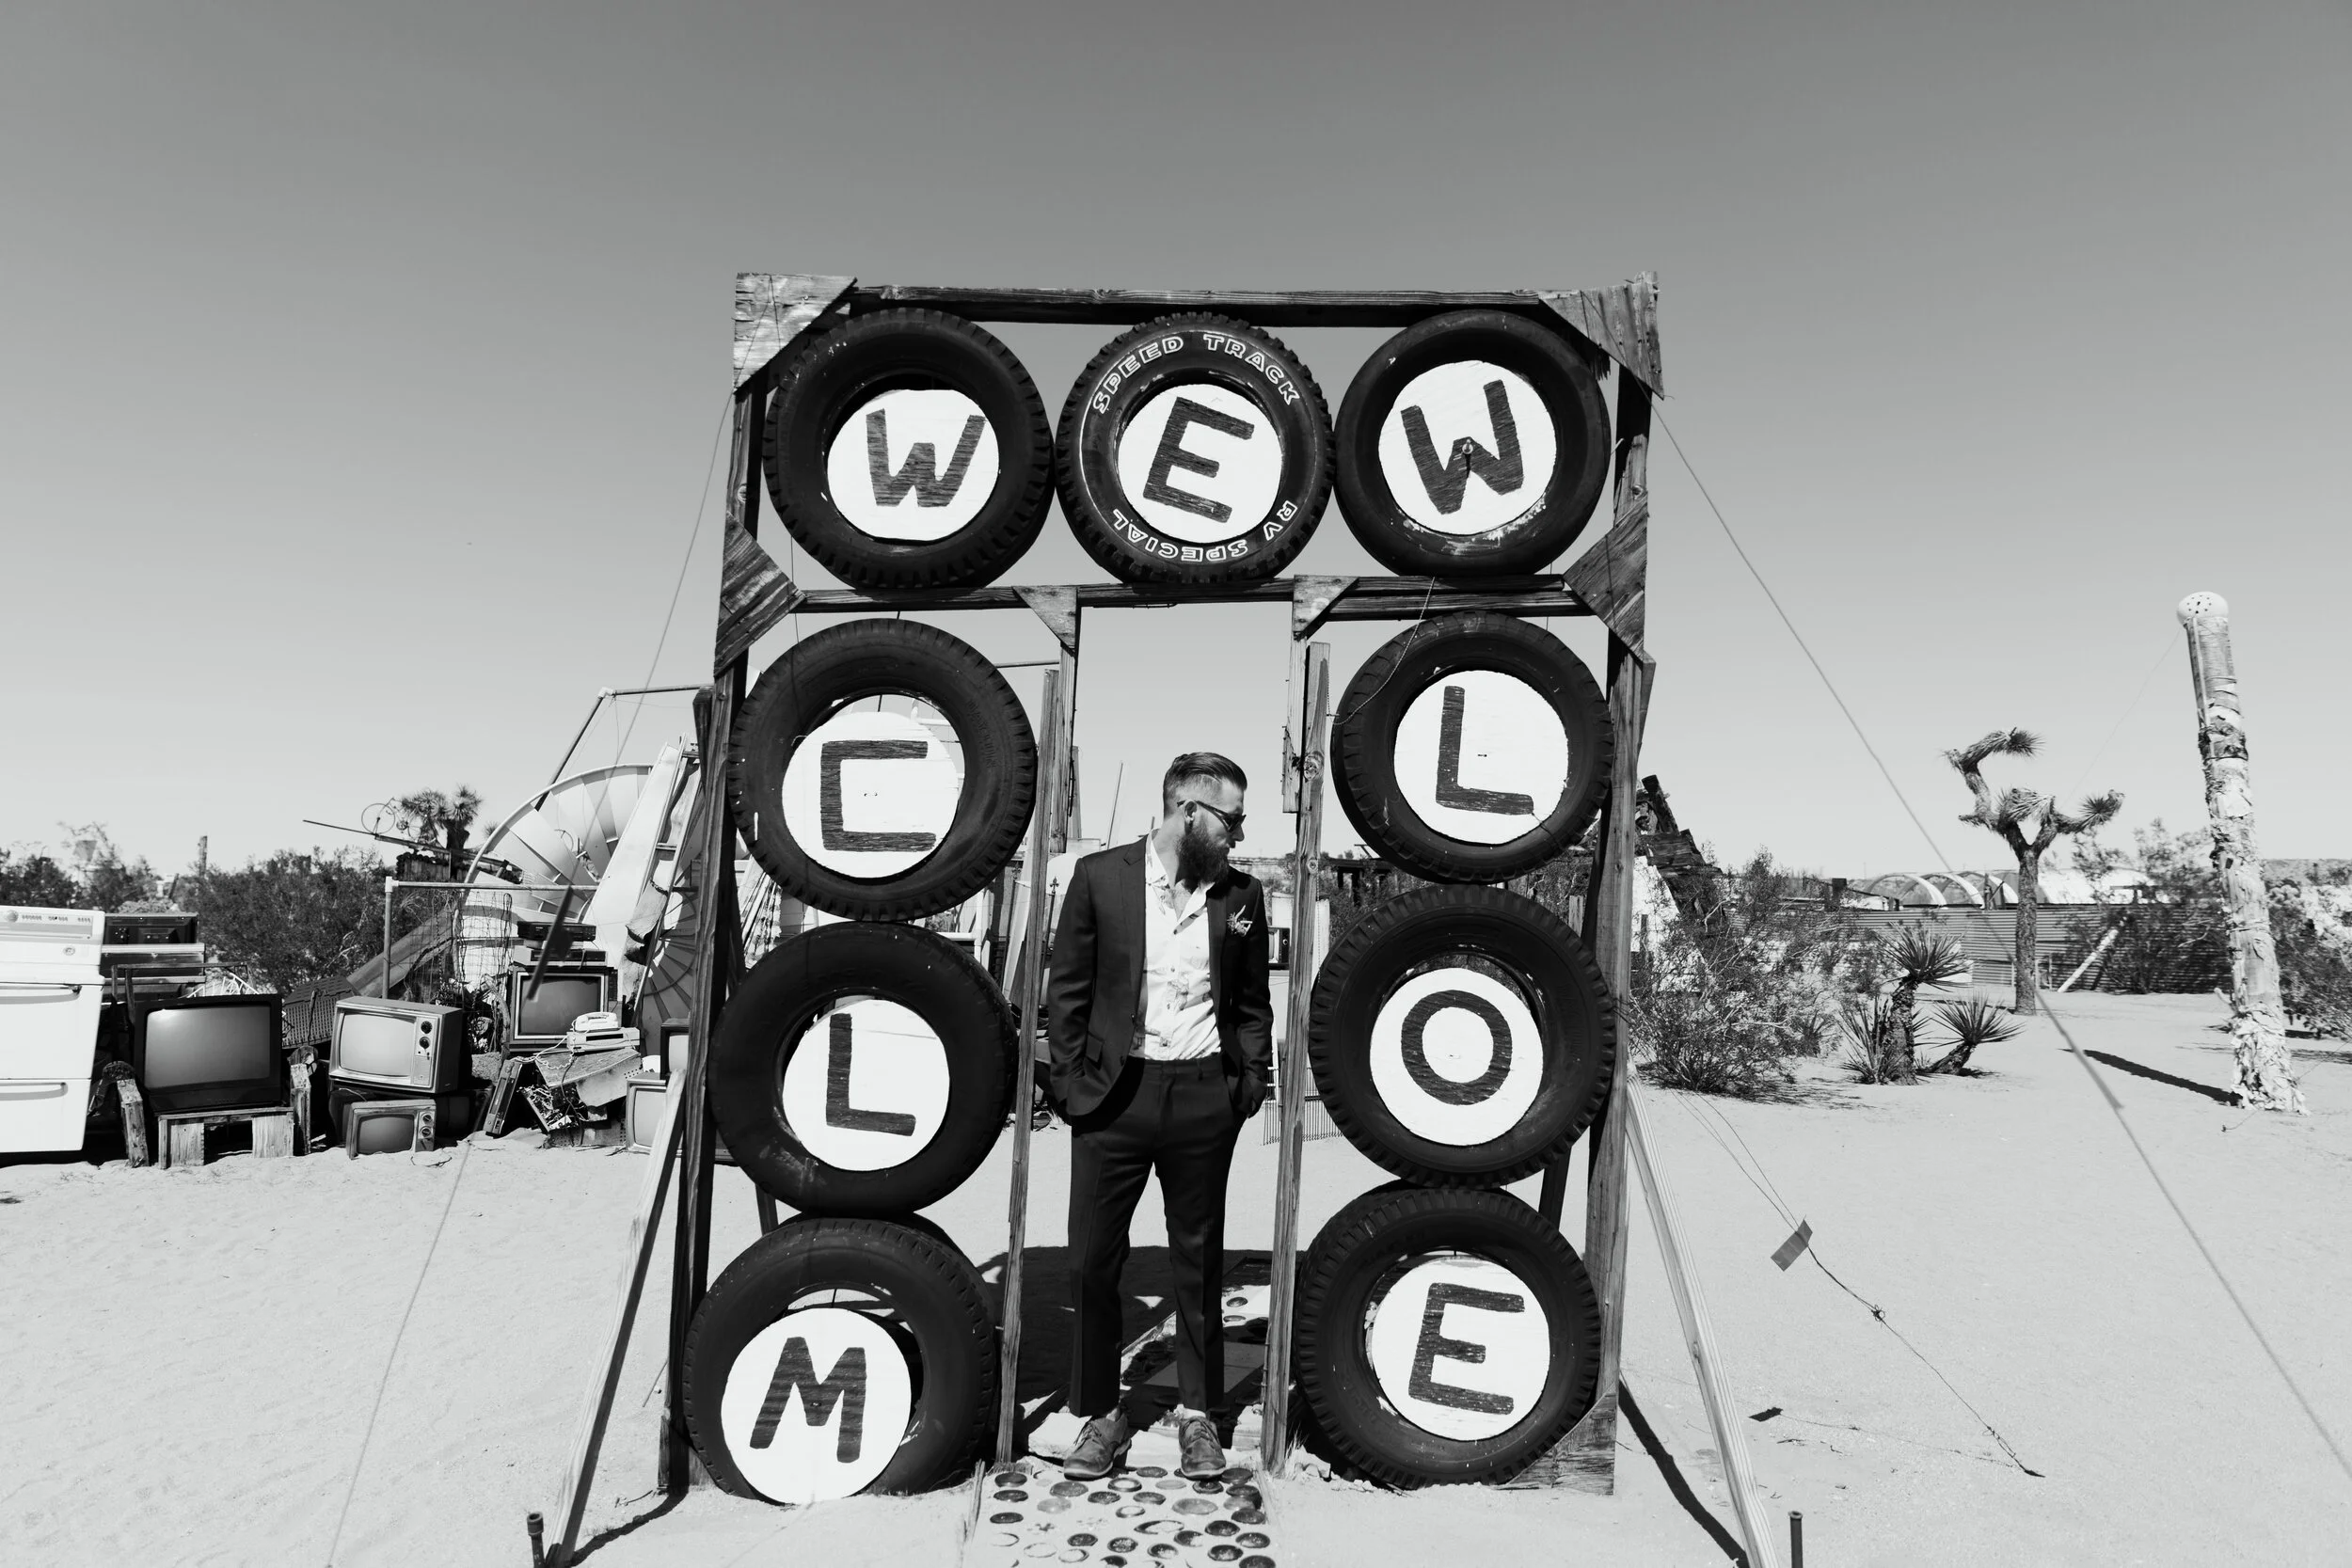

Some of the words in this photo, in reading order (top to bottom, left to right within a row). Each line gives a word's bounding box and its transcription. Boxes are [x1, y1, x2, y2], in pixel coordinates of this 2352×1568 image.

[1092, 336, 1184, 414] SPEED
[1203, 334, 1300, 405] TRACK
[866, 409, 986, 507] W
[1143, 397, 1254, 523] E
[1401, 380, 1523, 515] W
[1112, 508, 1248, 562] SPECIAL
[1263, 500, 1297, 541] RV
[820, 740, 936, 852] C
[1436, 686, 1534, 815] L
[826, 1013, 915, 1136] L
[1401, 990, 1512, 1105] O
[750, 1337, 866, 1463] M
[1408, 1283, 1525, 1415] E
